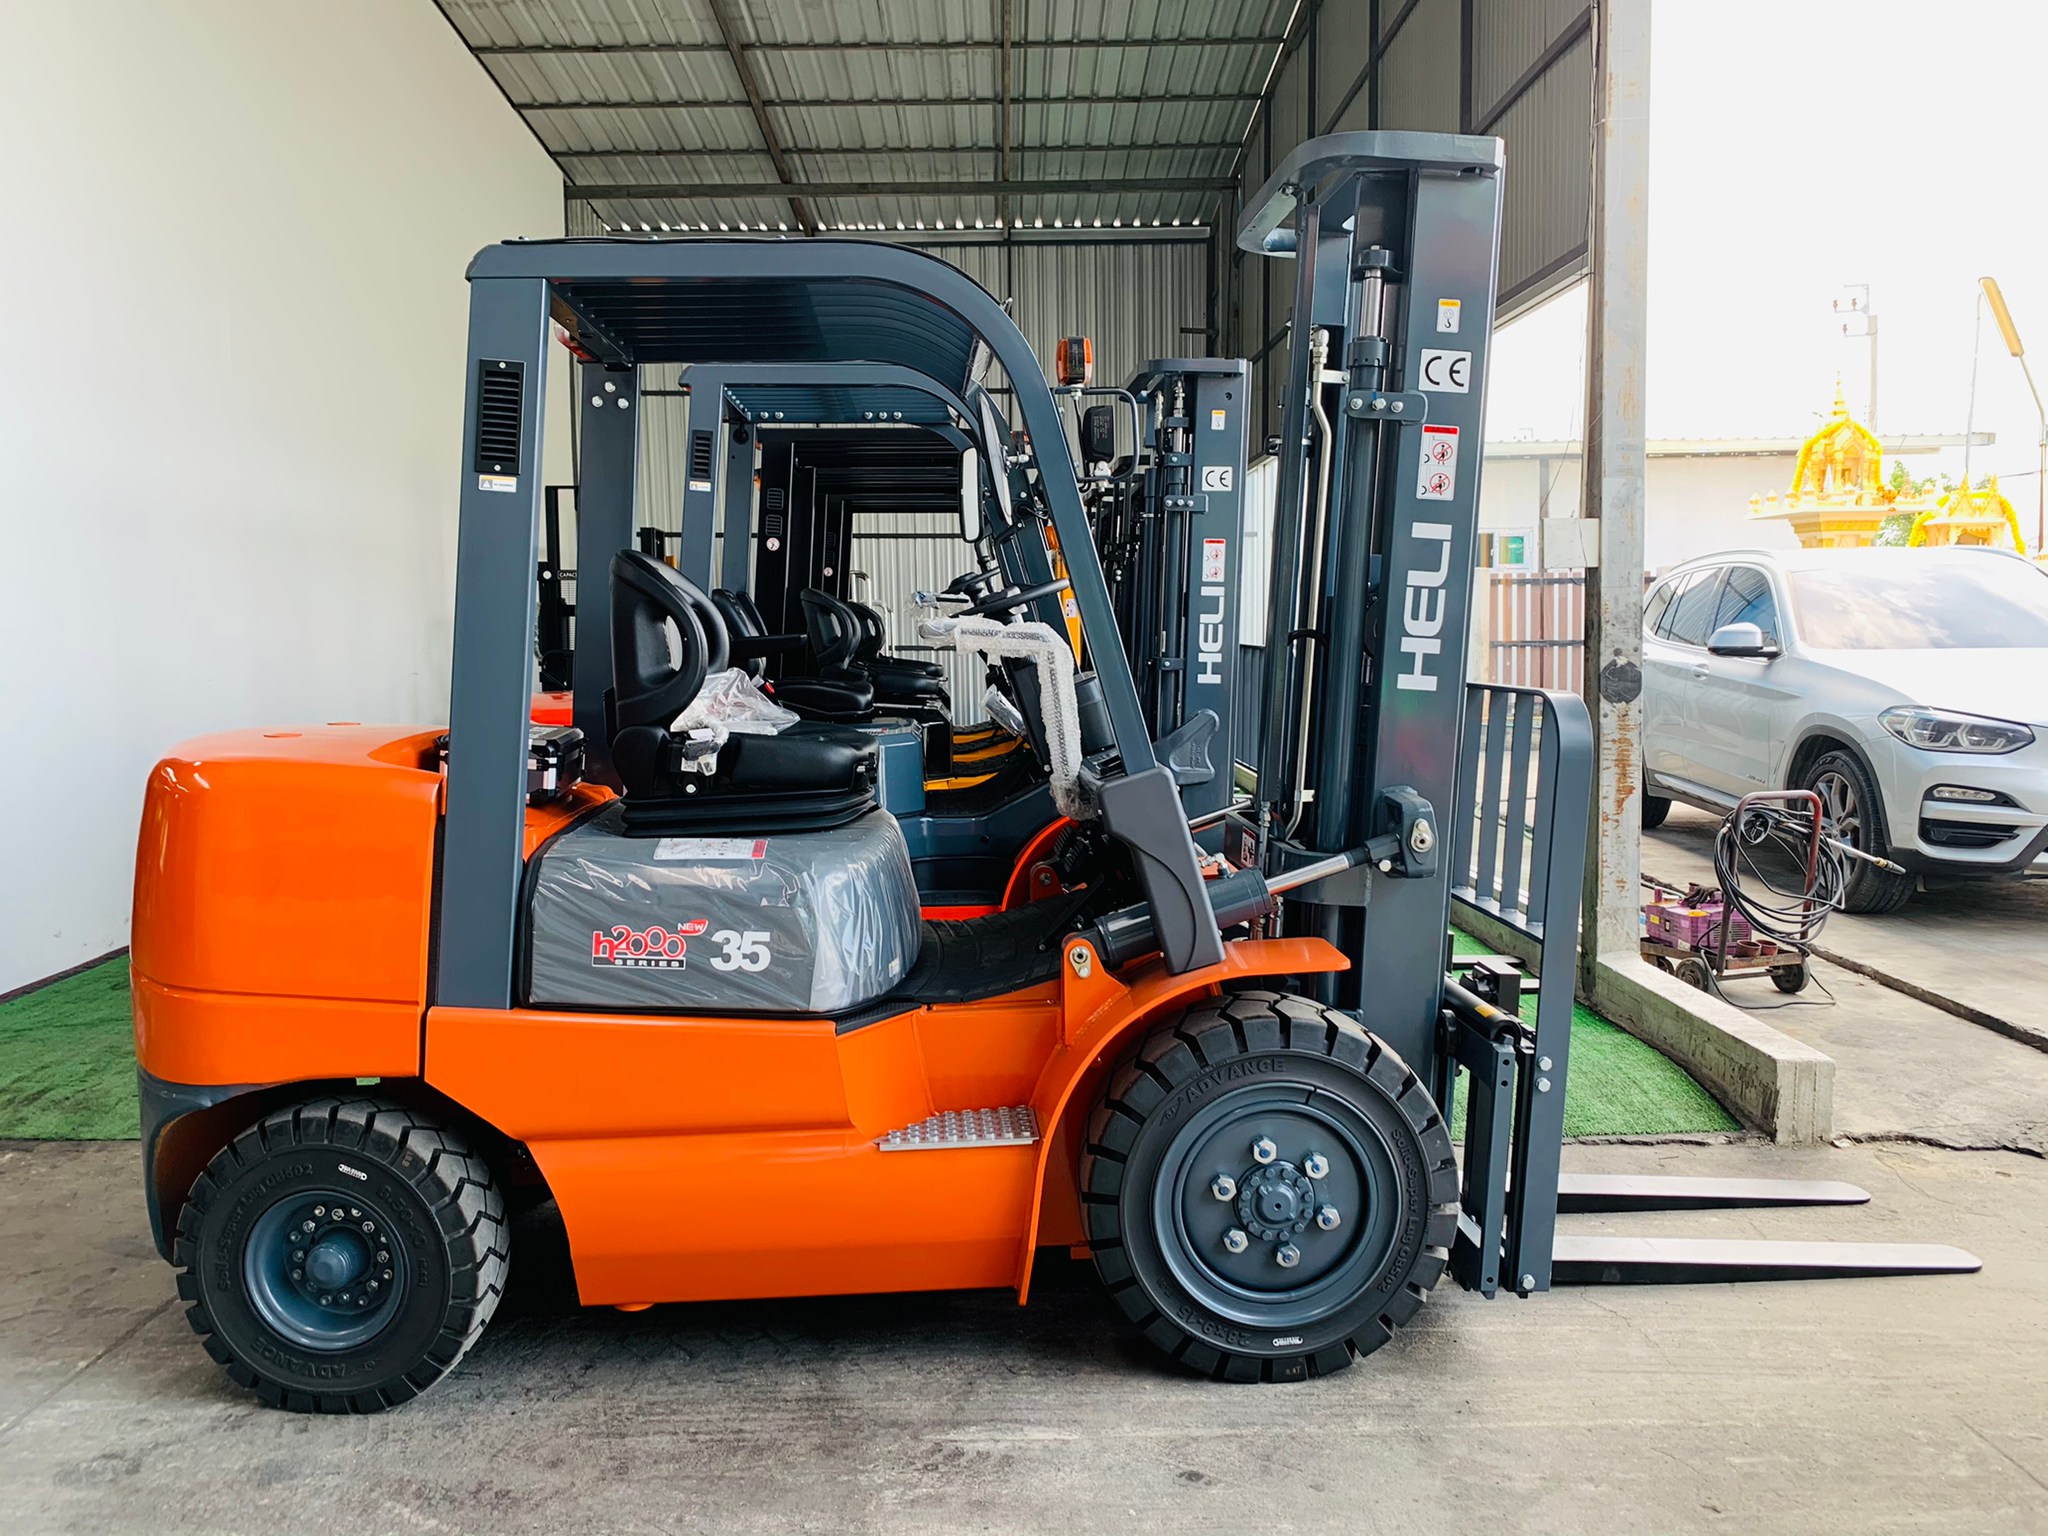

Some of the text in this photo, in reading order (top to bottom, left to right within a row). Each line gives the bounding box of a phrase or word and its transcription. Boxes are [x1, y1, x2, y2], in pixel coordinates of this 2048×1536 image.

[1424, 355, 1467, 388] CE
[1204, 469, 1230, 488] CE
[1396, 521, 1454, 692] HELI
[1196, 585, 1226, 685] HELI
[677, 921, 706, 932] NEW
[613, 957, 681, 968] SERIES
[709, 928, 772, 972] 35
[1185, 1057, 1288, 1104] ADVANCE
[1391, 1126, 1420, 1214] Solid-Super
[1401, 1216, 1420, 1244] Lug
[1175, 1303, 1253, 1348] 28x9-15
